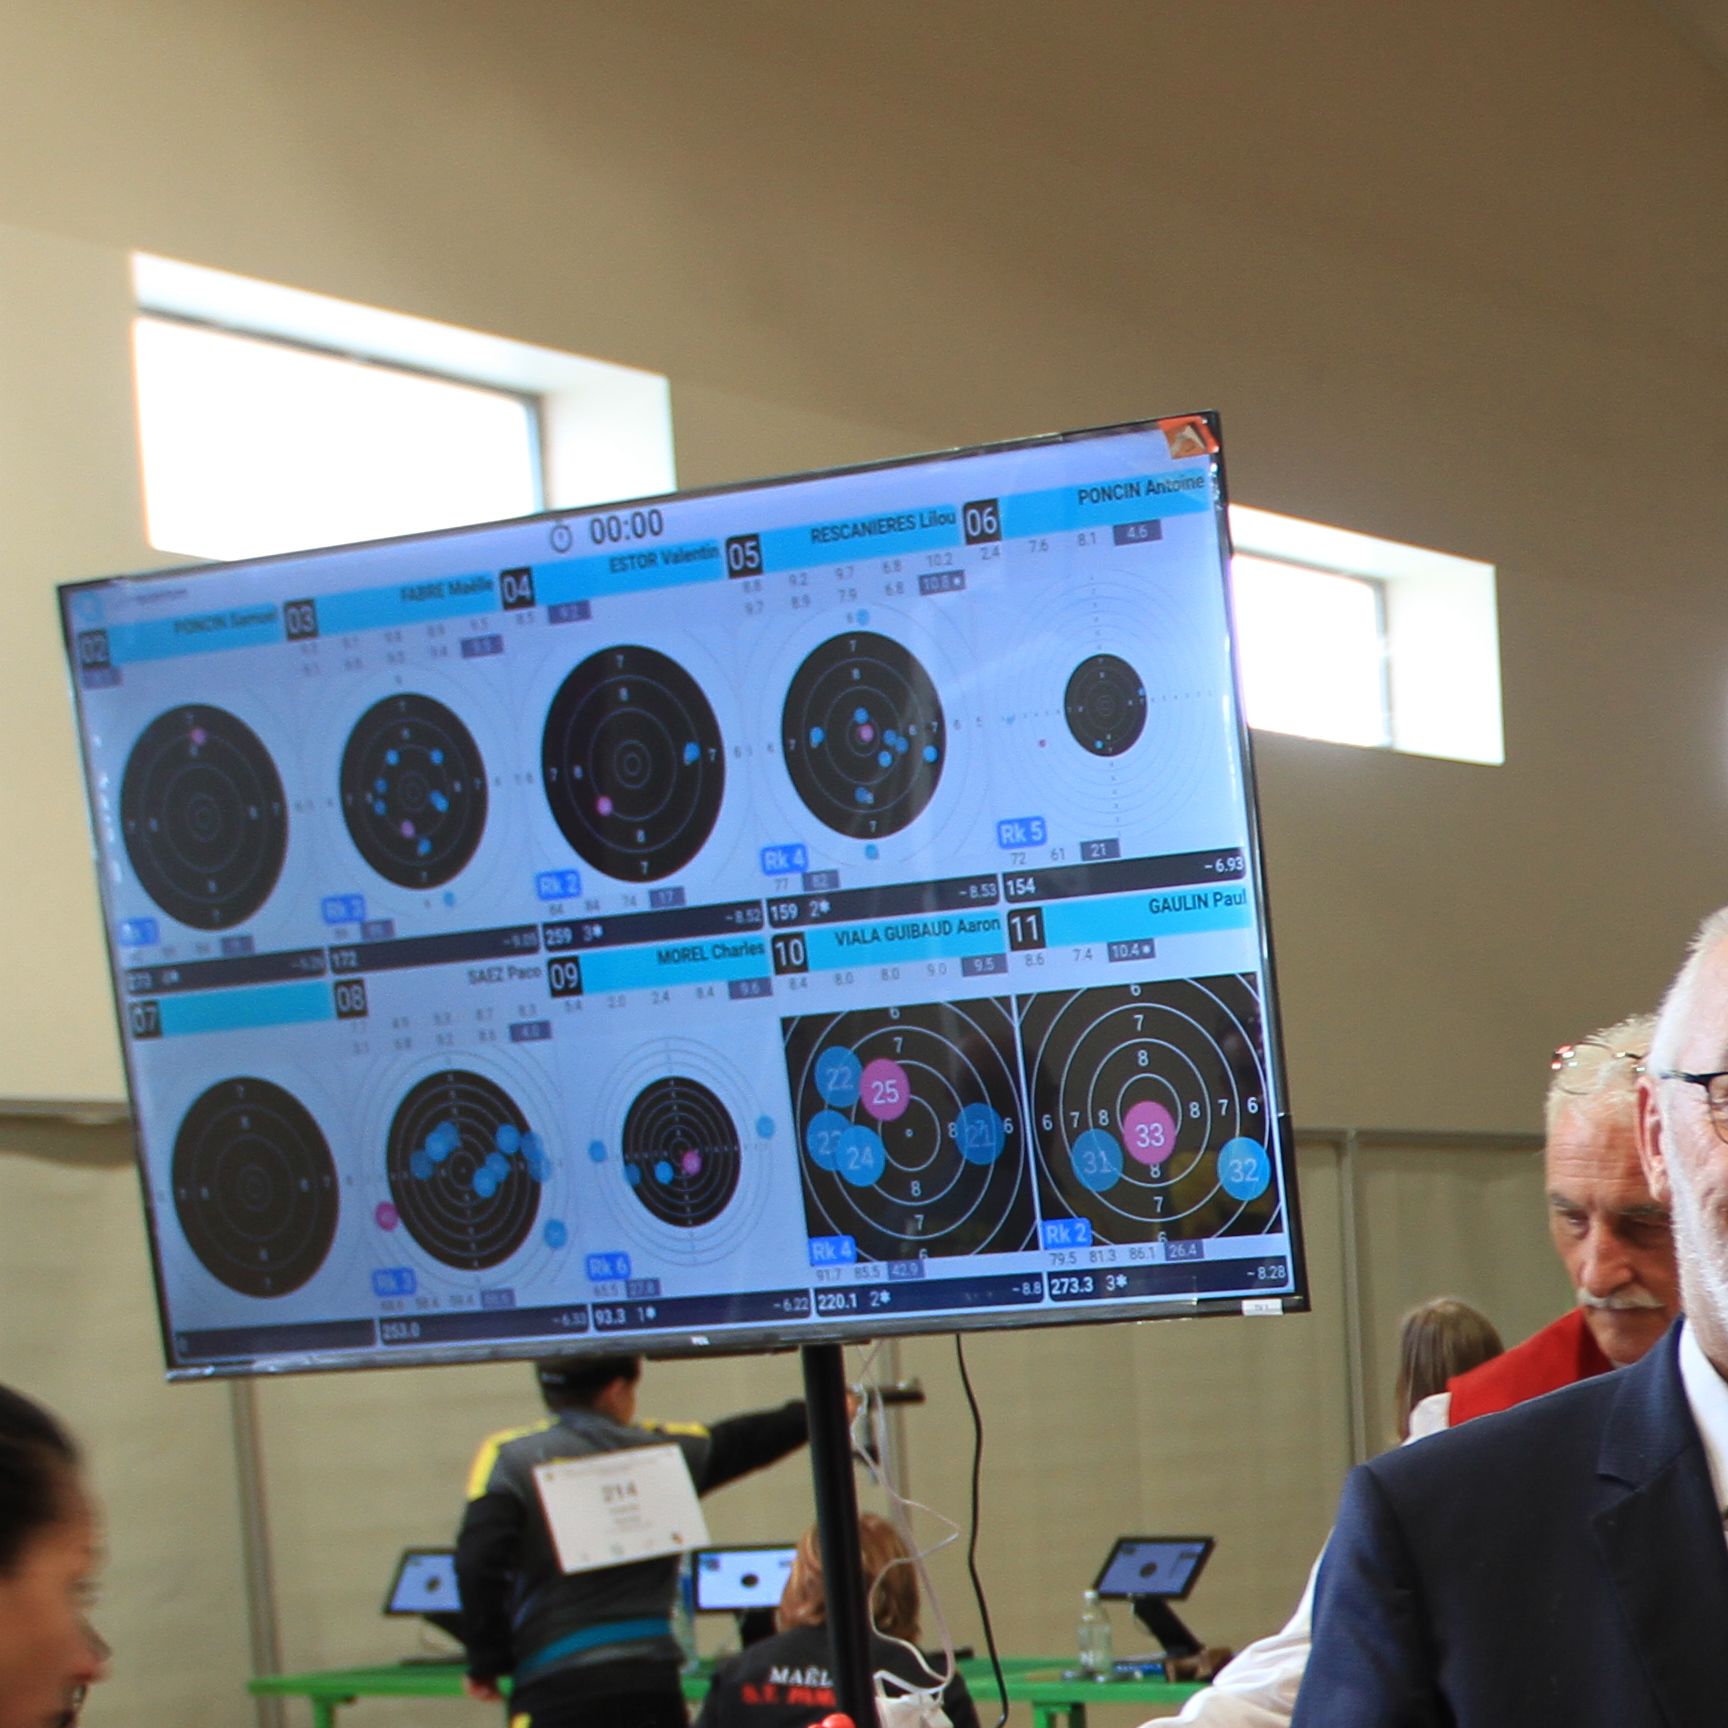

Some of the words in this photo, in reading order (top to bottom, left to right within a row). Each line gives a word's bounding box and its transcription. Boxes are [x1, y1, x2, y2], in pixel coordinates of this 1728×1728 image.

[1078, 482, 1141, 505] PONCIN
[1146, 475, 1205, 496] Antoine
[590, 508, 663, 544] 00:00
[811, 515, 916, 543] RESCANIERES
[920, 509, 956, 528] Lilou
[965, 507, 998, 537] 06
[1126, 524, 1148, 538] 4.6
[609, 553, 660, 574] ESTOR
[661, 545, 720, 566] Valentin
[727, 541, 761, 571] 05
[502, 575, 532, 604] 04
[286, 604, 317, 634] 03
[1001, 825, 1026, 845] Rk
[1031, 821, 1043, 841] 5
[764, 850, 788, 871] Rk
[793, 849, 805, 867] 4
[1011, 852, 1026, 866] 72
[1091, 845, 1107, 859] 21
[1006, 878, 1036, 895] 154
[1149, 893, 1209, 914] GAULIN
[1213, 888, 1246, 908] Paul
[770, 903, 799, 921] 159
[545, 928, 573, 945] 259
[835, 929, 880, 947] VIALA
[884, 920, 952, 942] GUIBAUD
[957, 918, 1000, 935] Aaron
[1010, 915, 1039, 943] 11
[657, 946, 708, 965] MOREL
[713, 941, 766, 959] Charles
[775, 939, 806, 967] 10
[1025, 952, 1044, 967] 8.6
[467, 967, 503, 985] SAEZ
[507, 965, 542, 981] Paco
[974, 958, 995, 972] 9.5
[551, 962, 580, 991] 09
[336, 985, 366, 1012] 08
[1133, 1014, 1145, 1031] 7
[894, 1037, 903, 1053] 7
[1137, 1050, 1149, 1067] 8
[872, 1079, 900, 1105] 25
[1189, 1102, 1200, 1118] 8
[1218, 1099, 1229, 1116] 7
[1247, 1097, 1258, 1113] 6
[1004, 1118, 1014, 1134] 6
[1042, 1115, 1053, 1130] 6
[1070, 1112, 1081, 1128] 7
[1098, 1109, 1109, 1126] 8
[1135, 1122, 1165, 1148] 33
[847, 1147, 874, 1170] 24
[1083, 1150, 1112, 1174] 31
[1230, 1158, 1260, 1183] 32
[911, 1180, 921, 1197] 8
[1154, 1196, 1164, 1213] 7
[914, 1214, 924, 1230] 7
[1046, 1224, 1071, 1243] Rk
[1075, 1223, 1087, 1241] 2
[812, 1242, 837, 1261] Rk
[841, 1241, 853, 1258] 4
[1051, 1252, 1078, 1265] 79.5
[1089, 1248, 1117, 1262] 81.3
[1170, 1244, 1197, 1258] 26.4
[816, 1268, 841, 1281] 91.7
[892, 1263, 918, 1276] 42.9
[1051, 1277, 1094, 1295] 273.3
[818, 1293, 858, 1311] 220.1
[595, 1308, 626, 1324] 93.3
